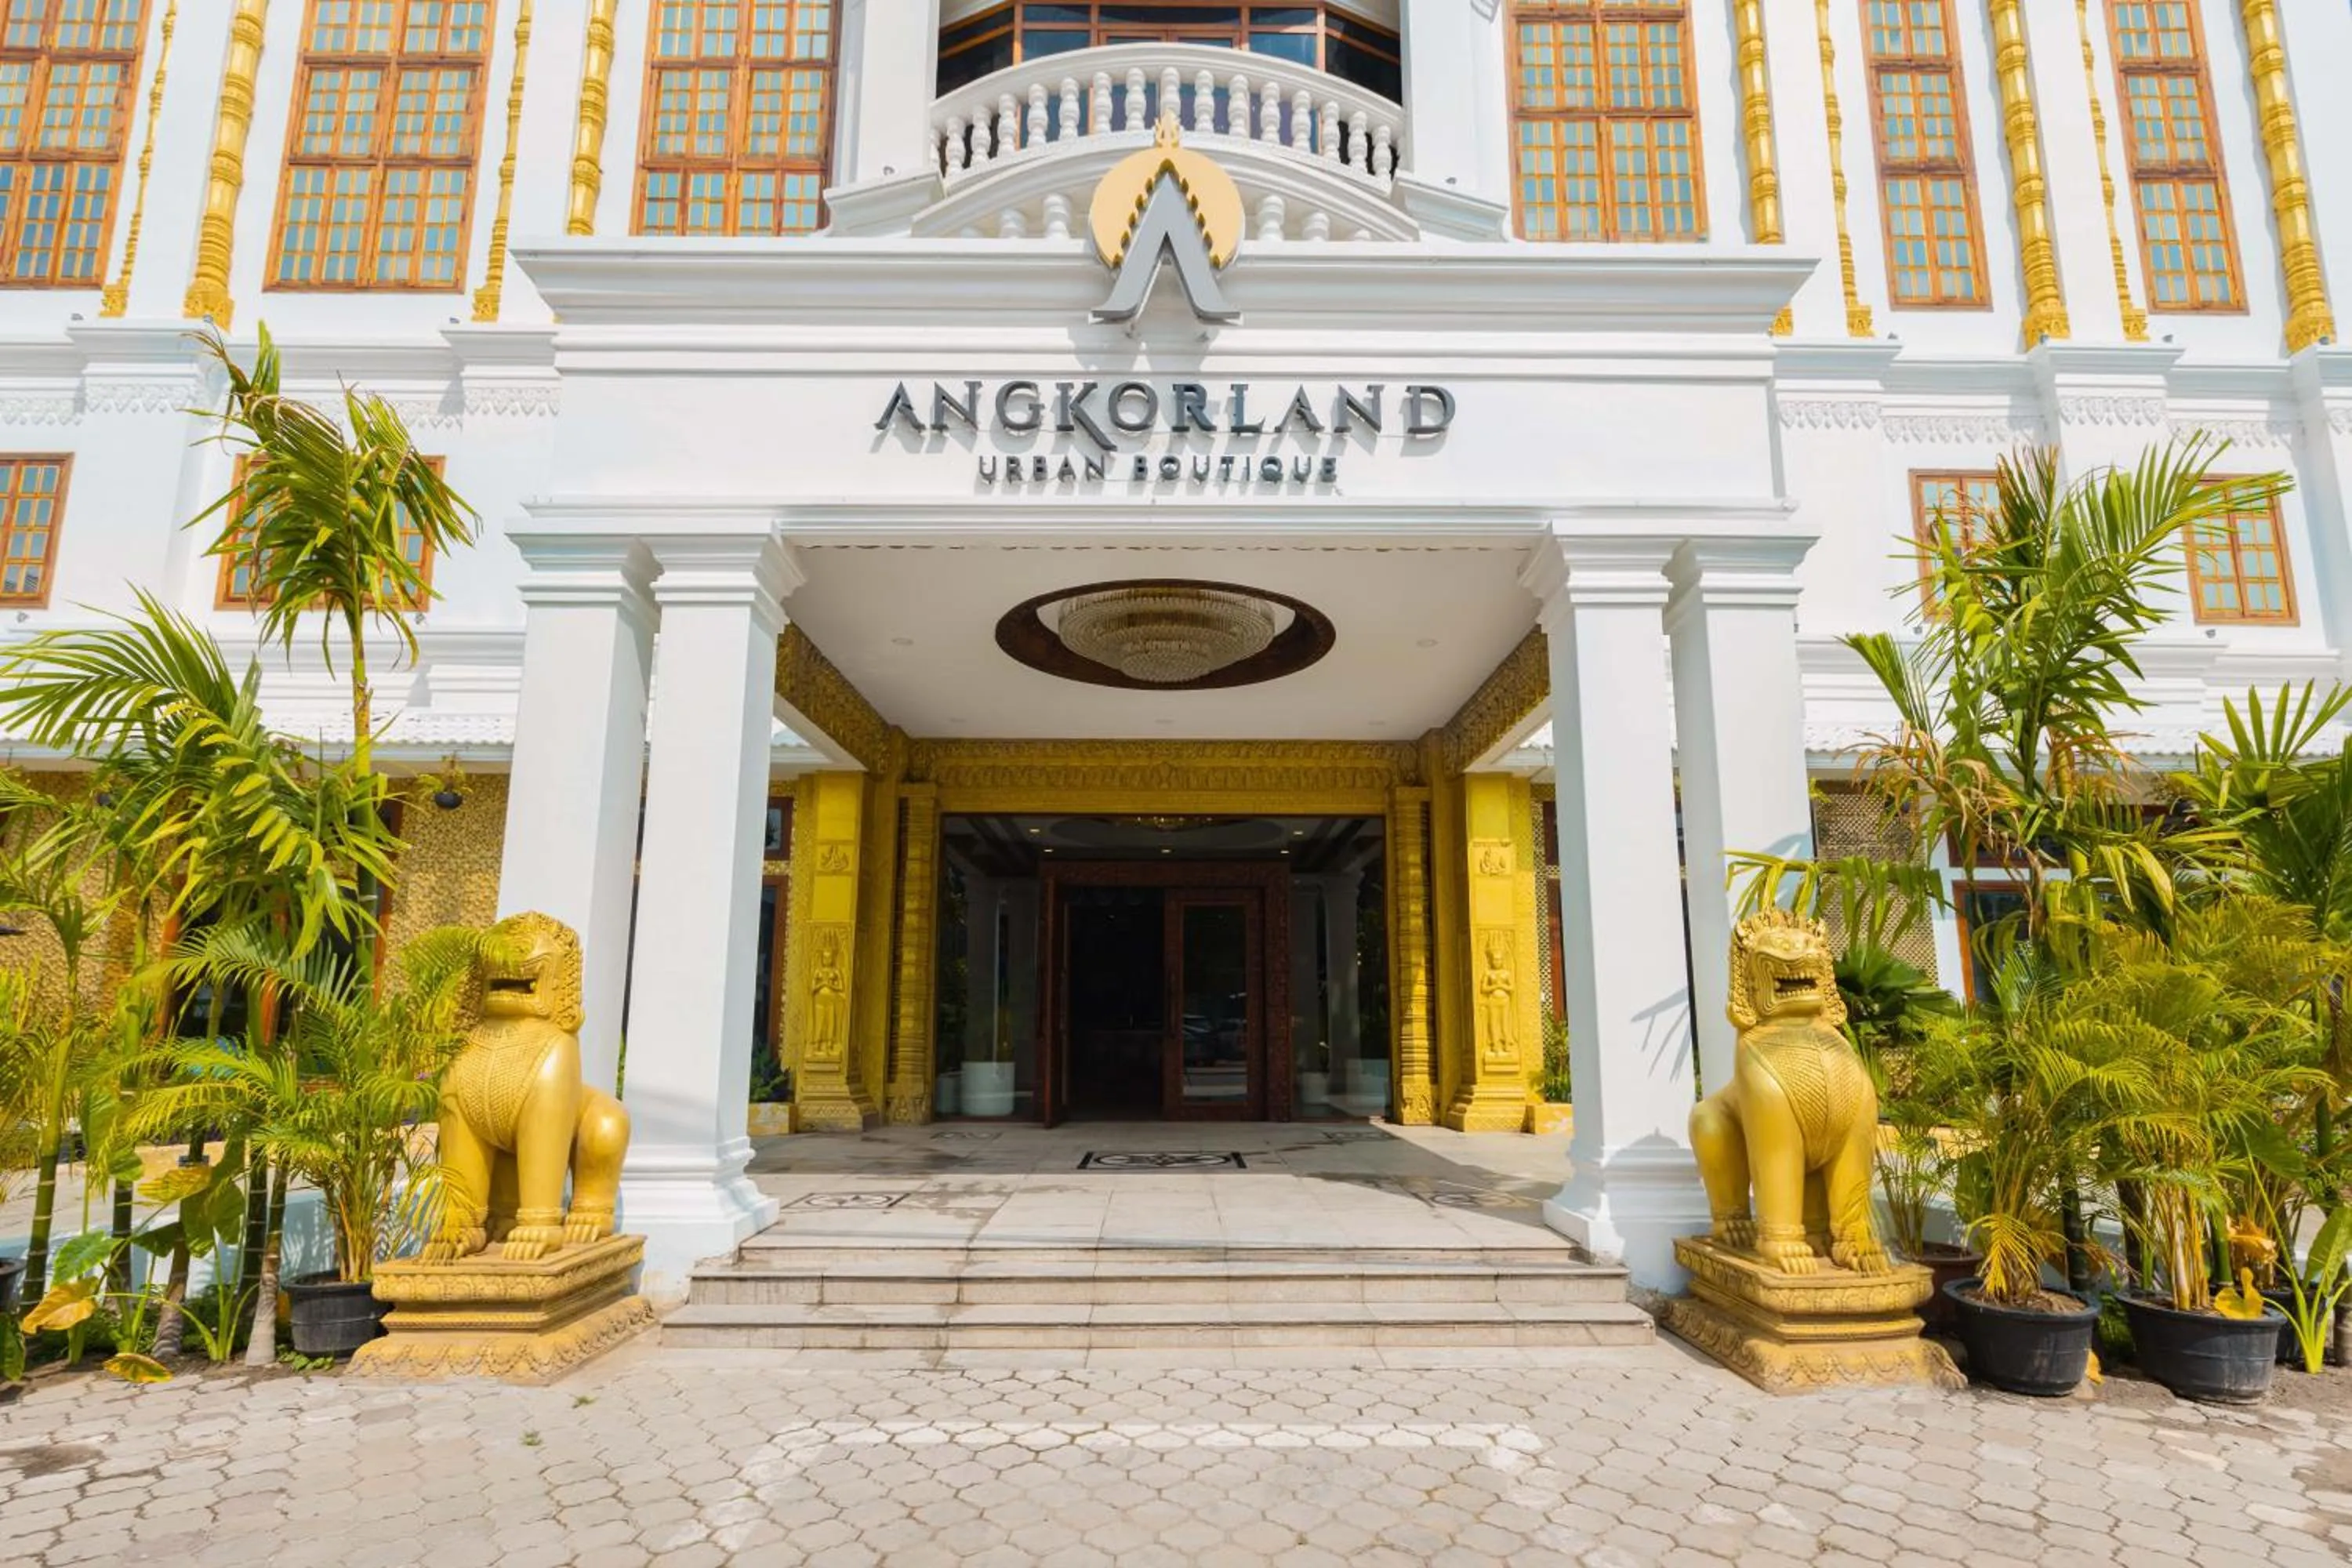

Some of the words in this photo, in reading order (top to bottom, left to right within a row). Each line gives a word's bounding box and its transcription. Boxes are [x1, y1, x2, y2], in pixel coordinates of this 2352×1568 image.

[874, 380, 1456, 451] ANGKORLAND
[978, 456, 1105, 484] URBAN
[1134, 456, 1337, 484] BOUTIQUE
